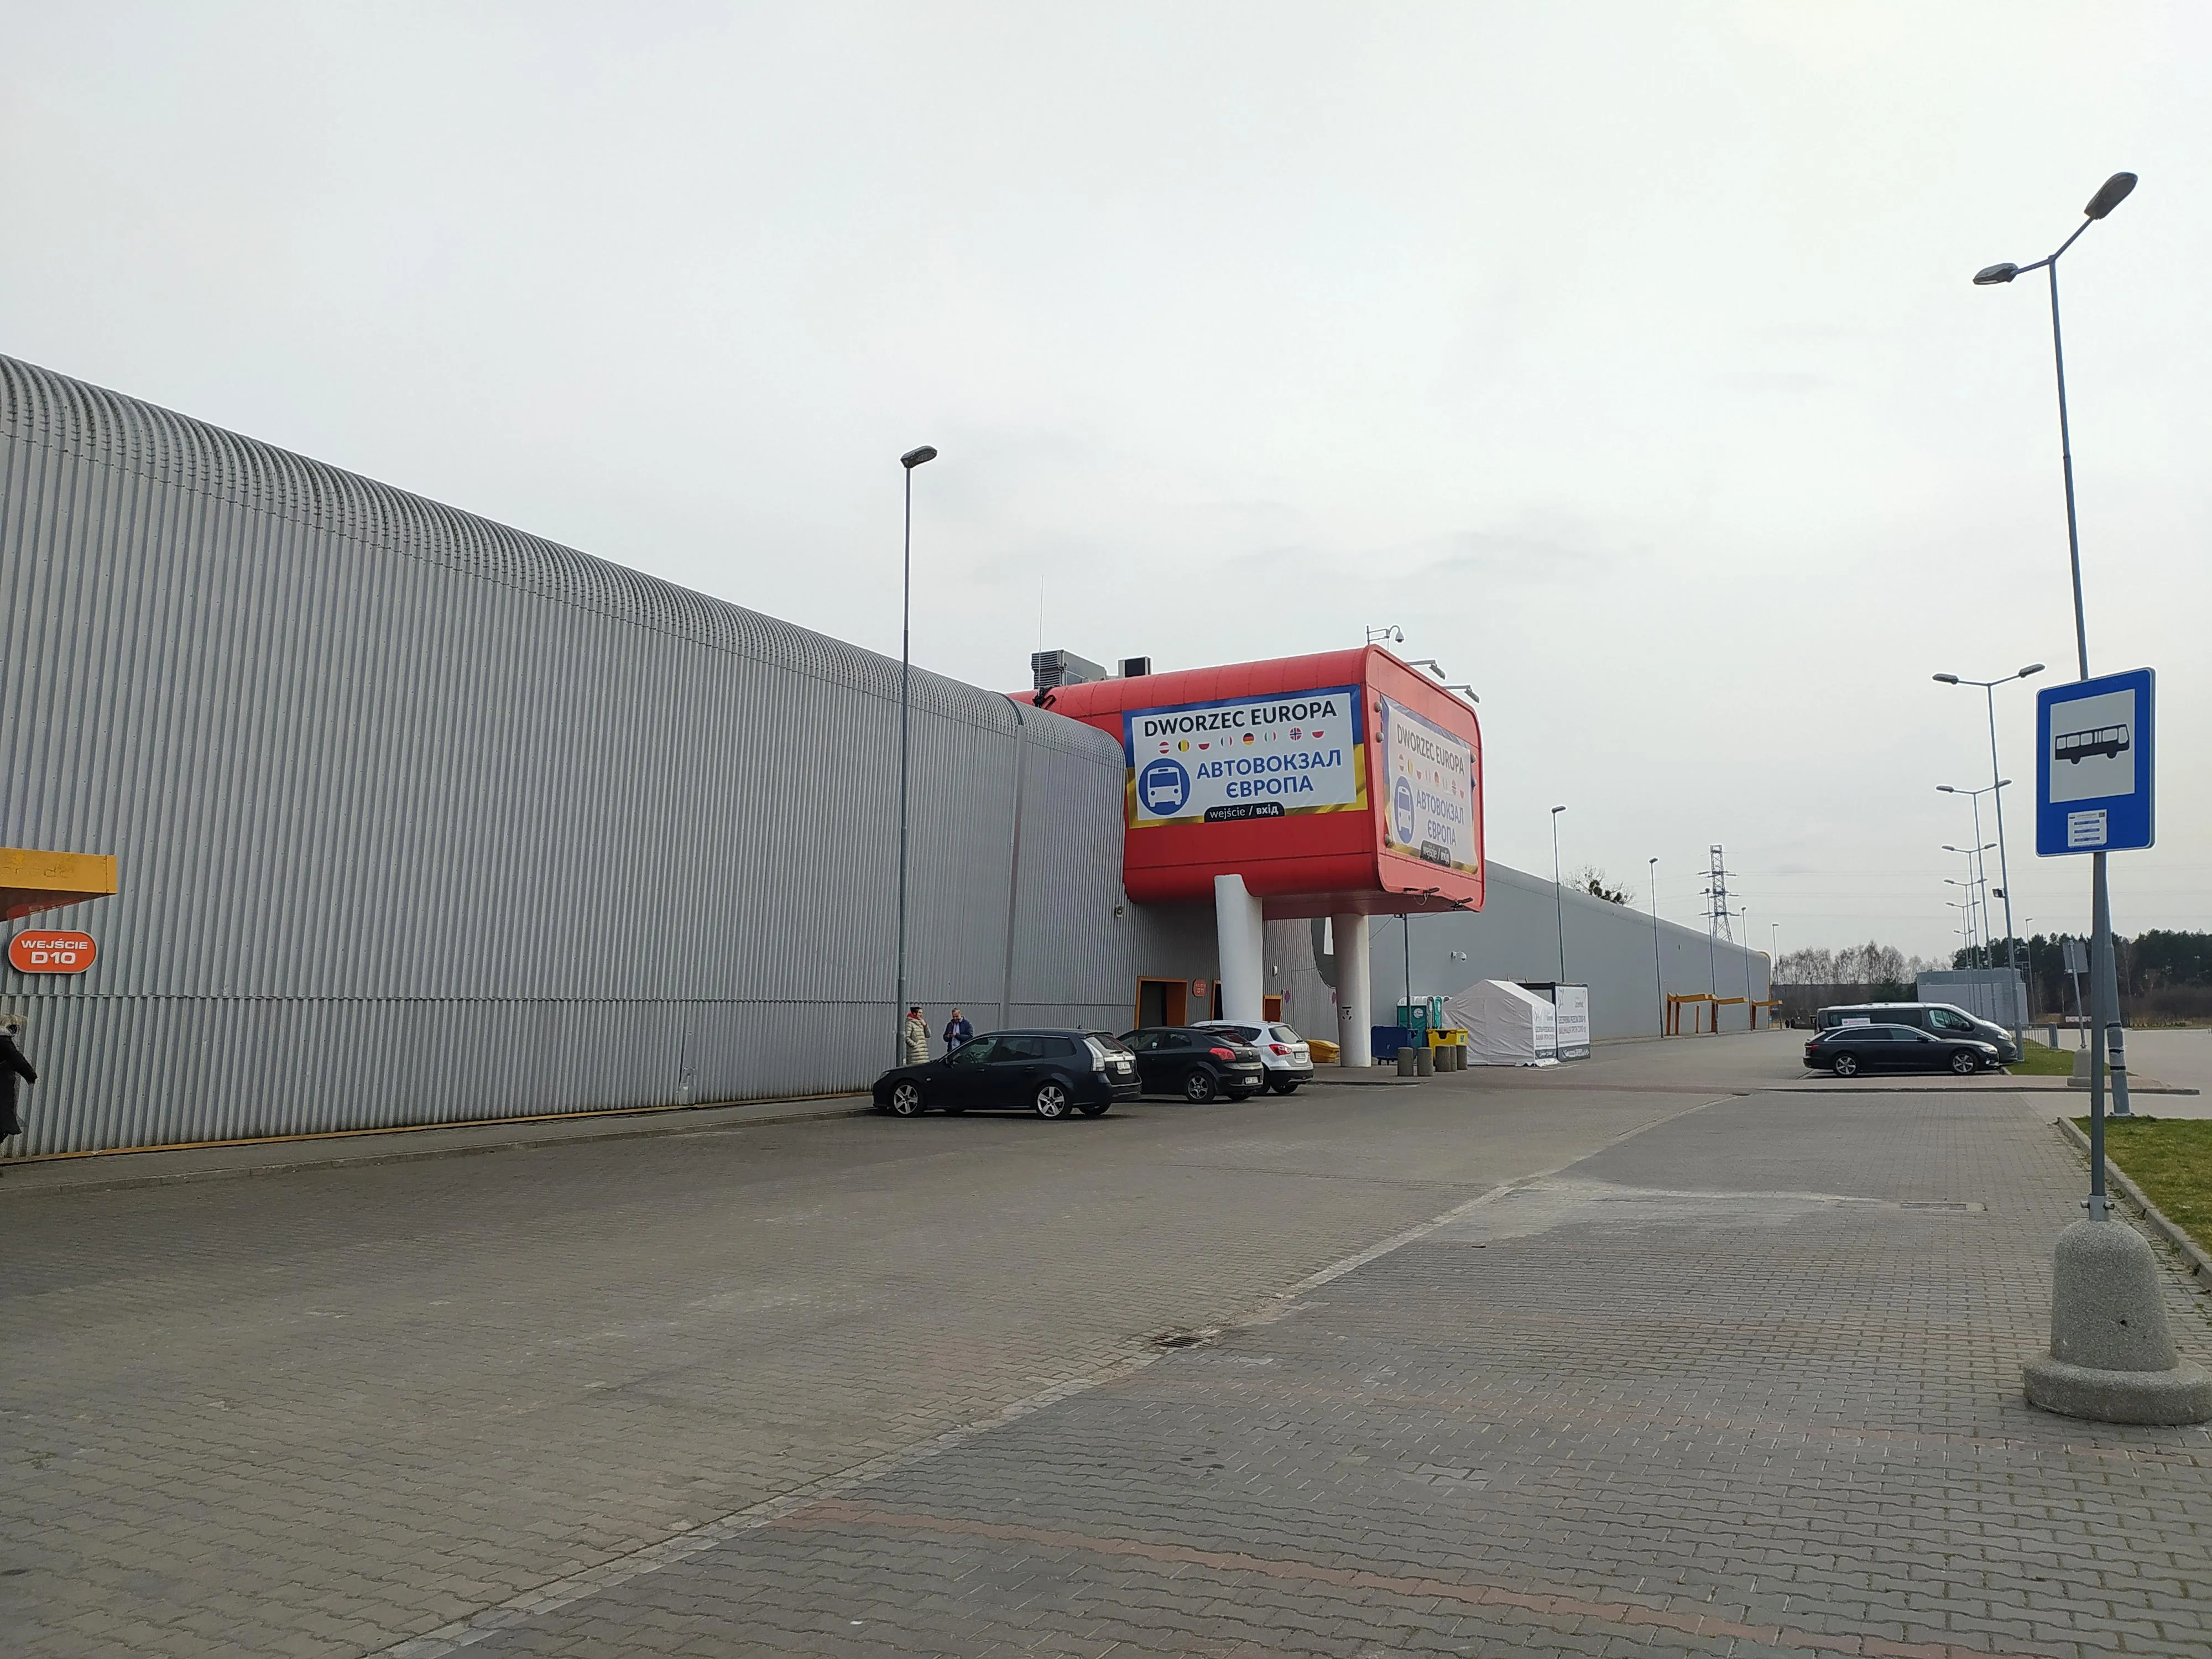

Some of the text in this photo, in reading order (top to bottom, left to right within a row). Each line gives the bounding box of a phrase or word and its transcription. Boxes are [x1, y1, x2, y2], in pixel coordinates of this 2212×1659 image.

[1144, 700, 1338, 738] DWORZEC EUROPA
[1396, 723, 1465, 776] DWORZEC EUROPA
[1196, 749, 1342, 780] АВТОВОКЗАЛ
[1226, 775, 1314, 799] ЄВРОПА
[1209, 806, 1246, 820] wejście
[1256, 805, 1279, 817] вхід
[1416, 789, 1464, 826] АВТОВОКЗАЛ
[1427, 819, 1457, 847] ЄВРОПА
[21, 938, 88, 950] WEJŚCIE
[31, 951, 76, 964] D10
